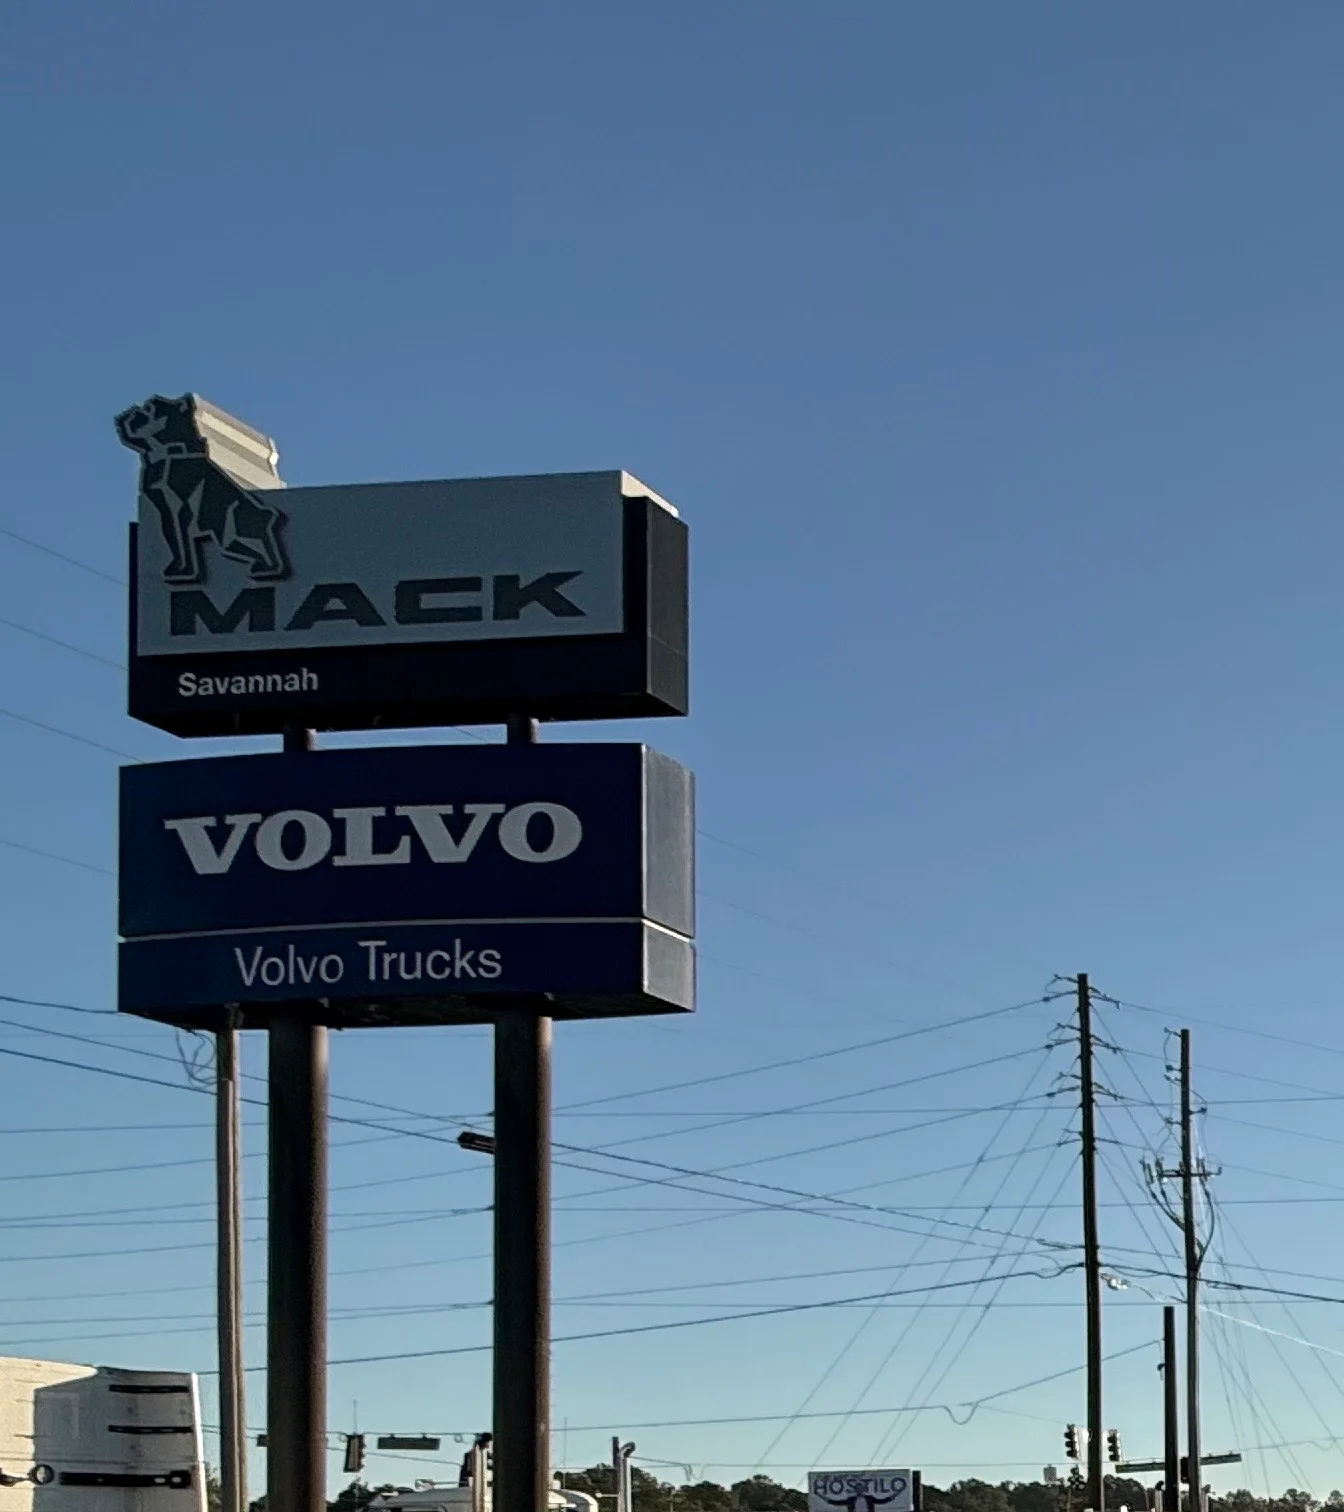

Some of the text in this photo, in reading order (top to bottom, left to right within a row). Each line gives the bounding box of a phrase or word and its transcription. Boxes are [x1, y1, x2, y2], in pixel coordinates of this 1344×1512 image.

[169, 571, 586, 635] MACK
[178, 668, 319, 697] Savannah
[164, 802, 583, 875] VOLVO
[234, 939, 502, 987] Volvo Trucks
[813, 1477, 907, 1495] HOSTILO
